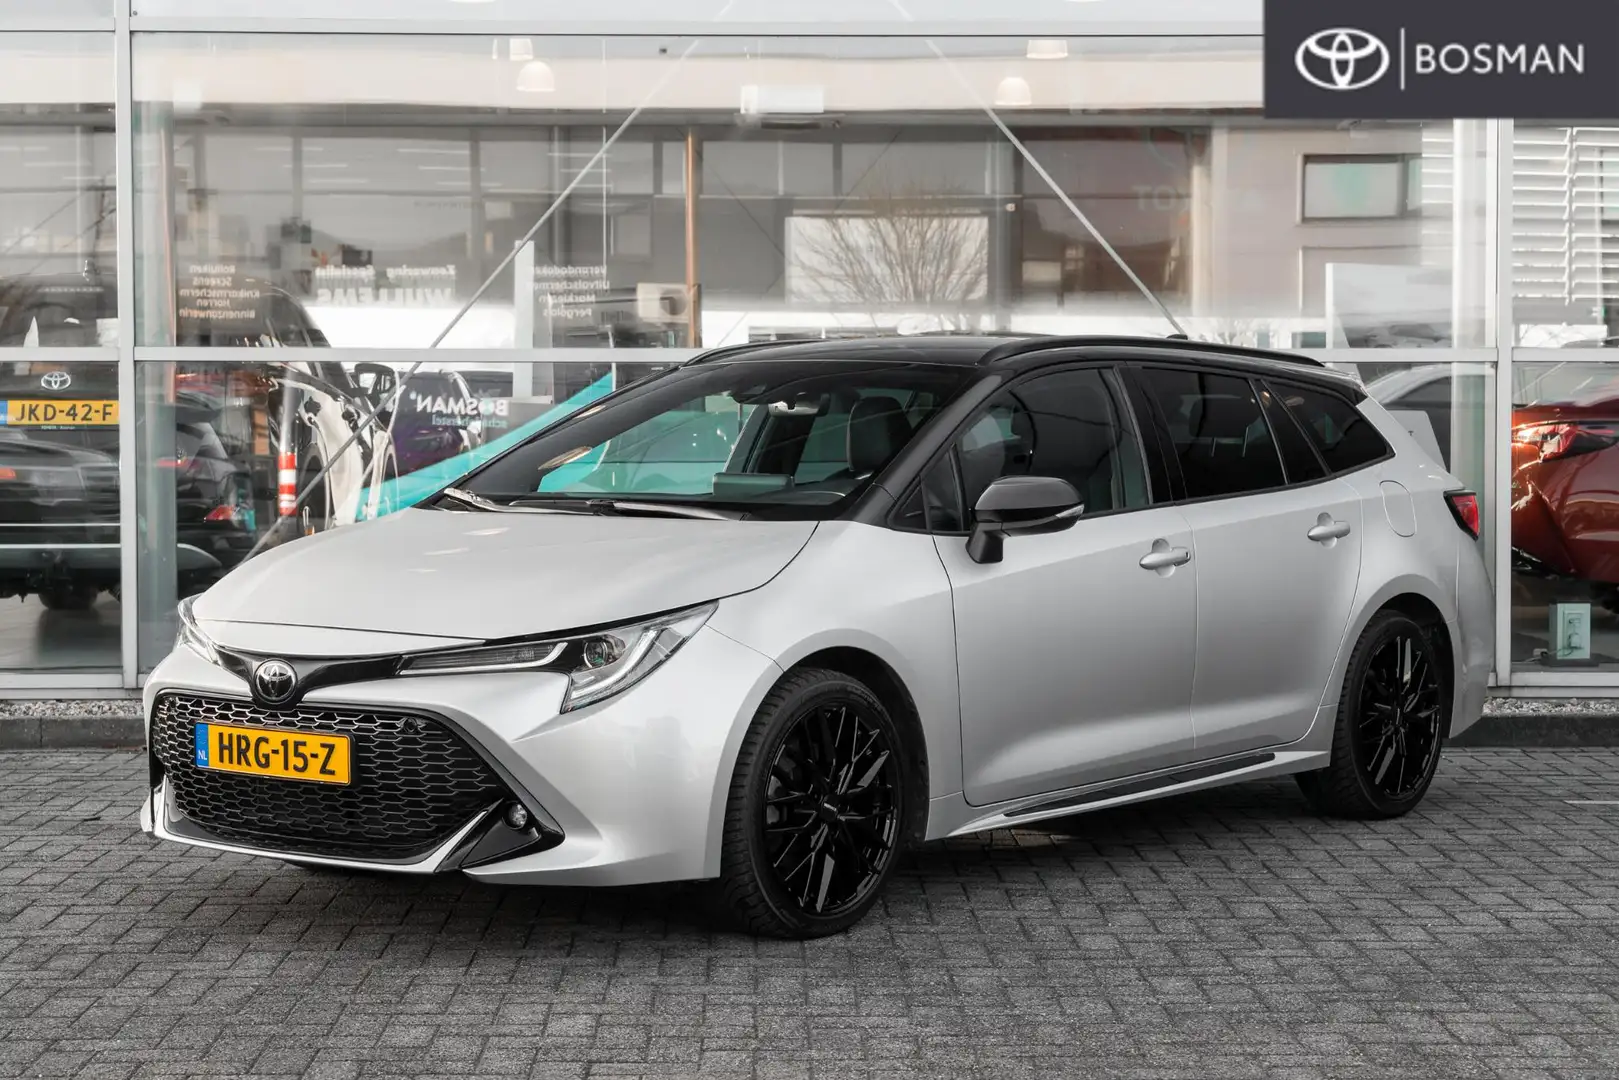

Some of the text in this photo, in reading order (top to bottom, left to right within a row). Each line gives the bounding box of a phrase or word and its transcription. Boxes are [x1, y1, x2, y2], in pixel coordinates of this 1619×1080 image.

[15, 403, 113, 422] JKD-42-F
[198, 749, 208, 761] NL
[218, 732, 336, 776] HRG-15-Z
